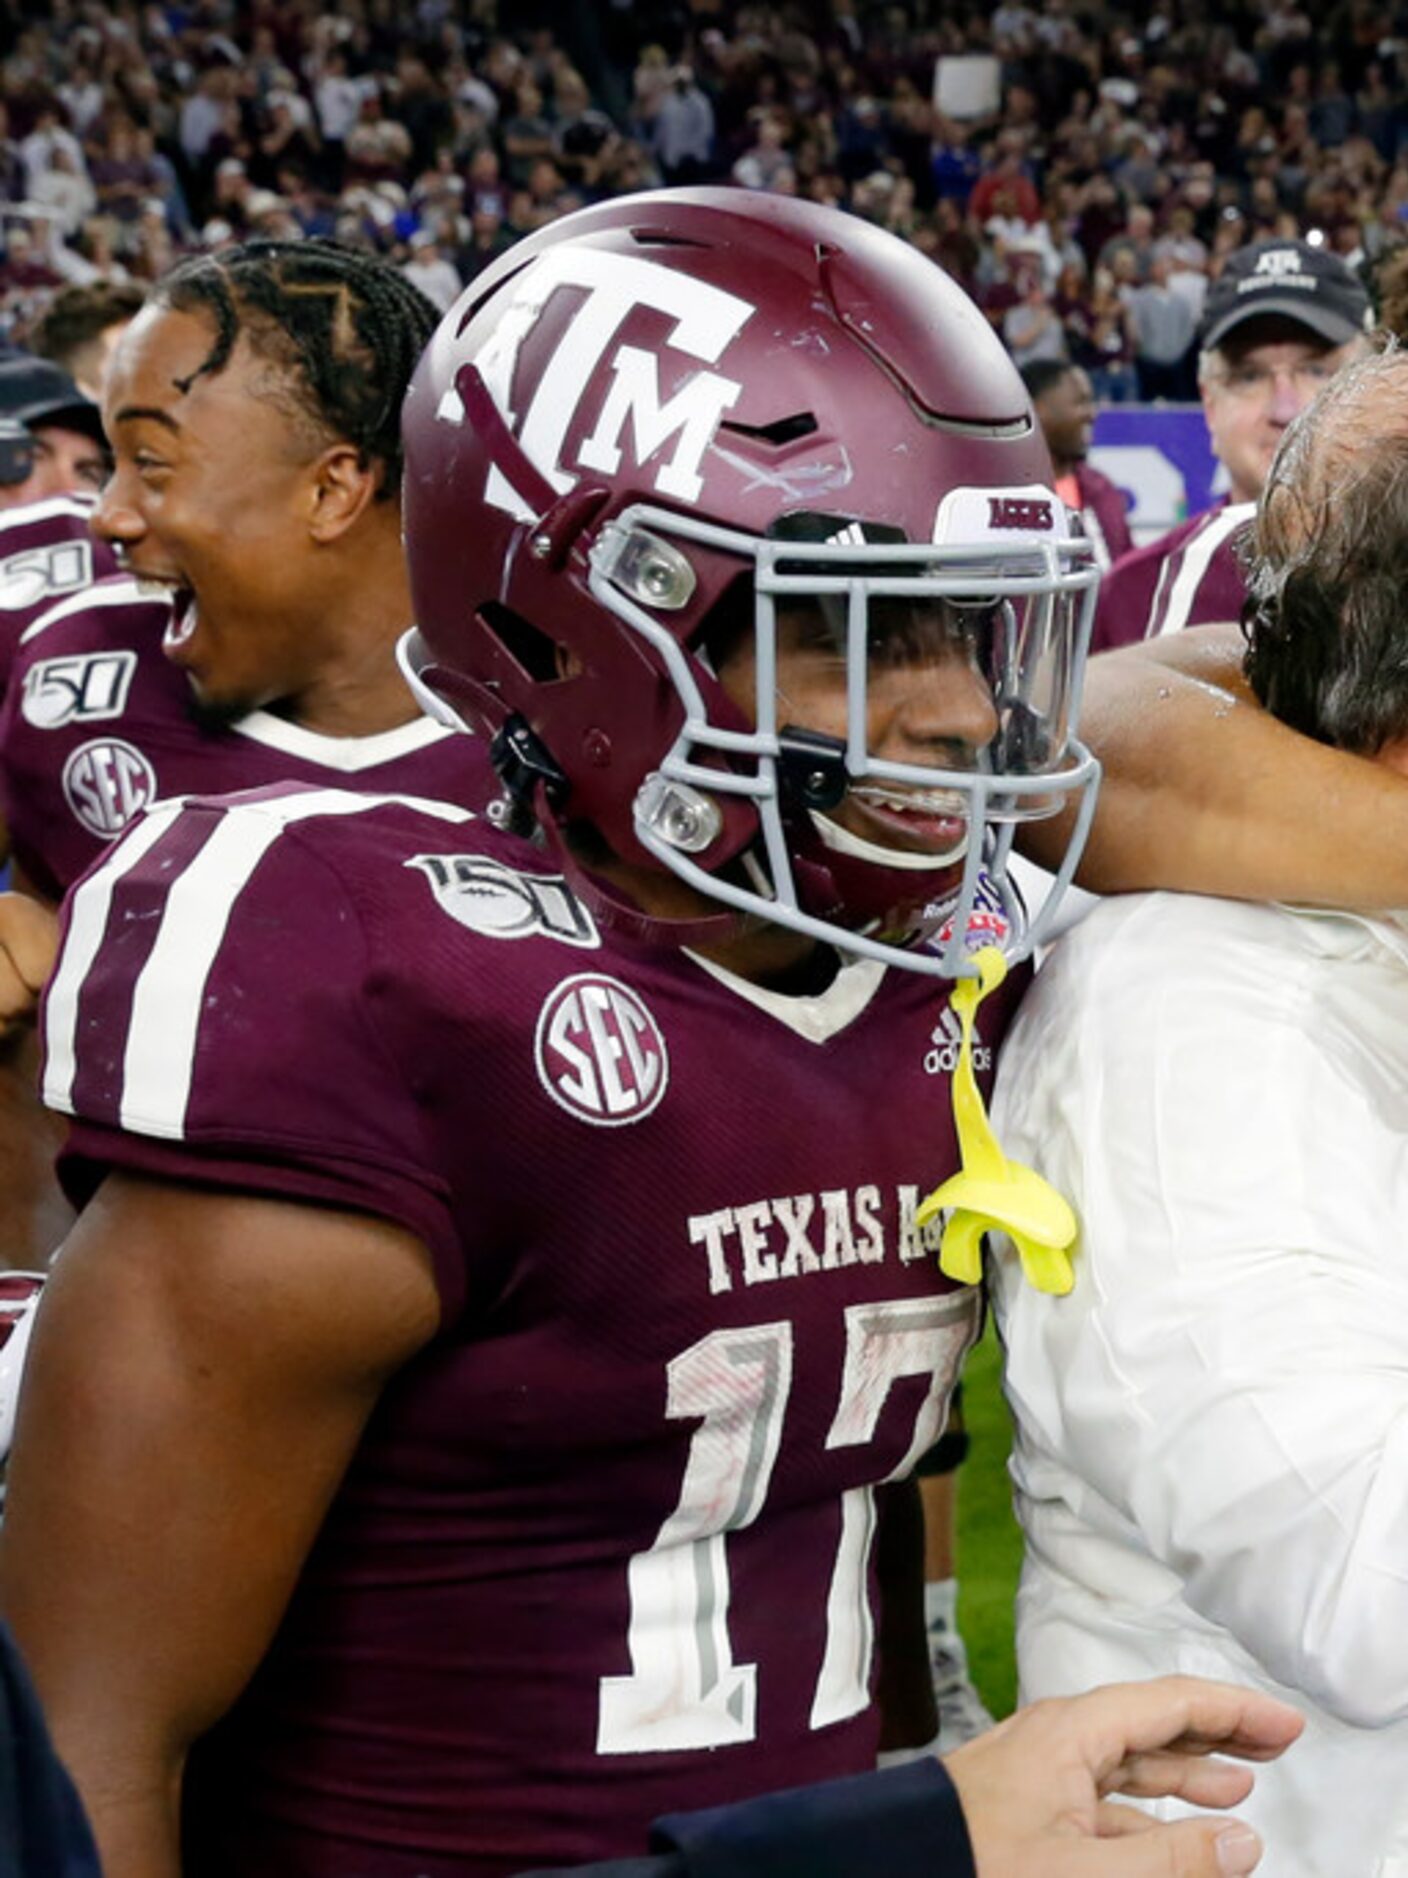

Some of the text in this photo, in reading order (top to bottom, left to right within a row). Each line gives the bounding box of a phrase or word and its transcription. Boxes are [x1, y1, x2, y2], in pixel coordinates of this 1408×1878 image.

[2, 543, 90, 606] 50
[68, 746, 149, 832] SEC
[412, 855, 598, 944] 150
[547, 984, 660, 1115] SEC
[687, 1184, 884, 1295] TEXAS
[596, 1286, 979, 1754] 17
